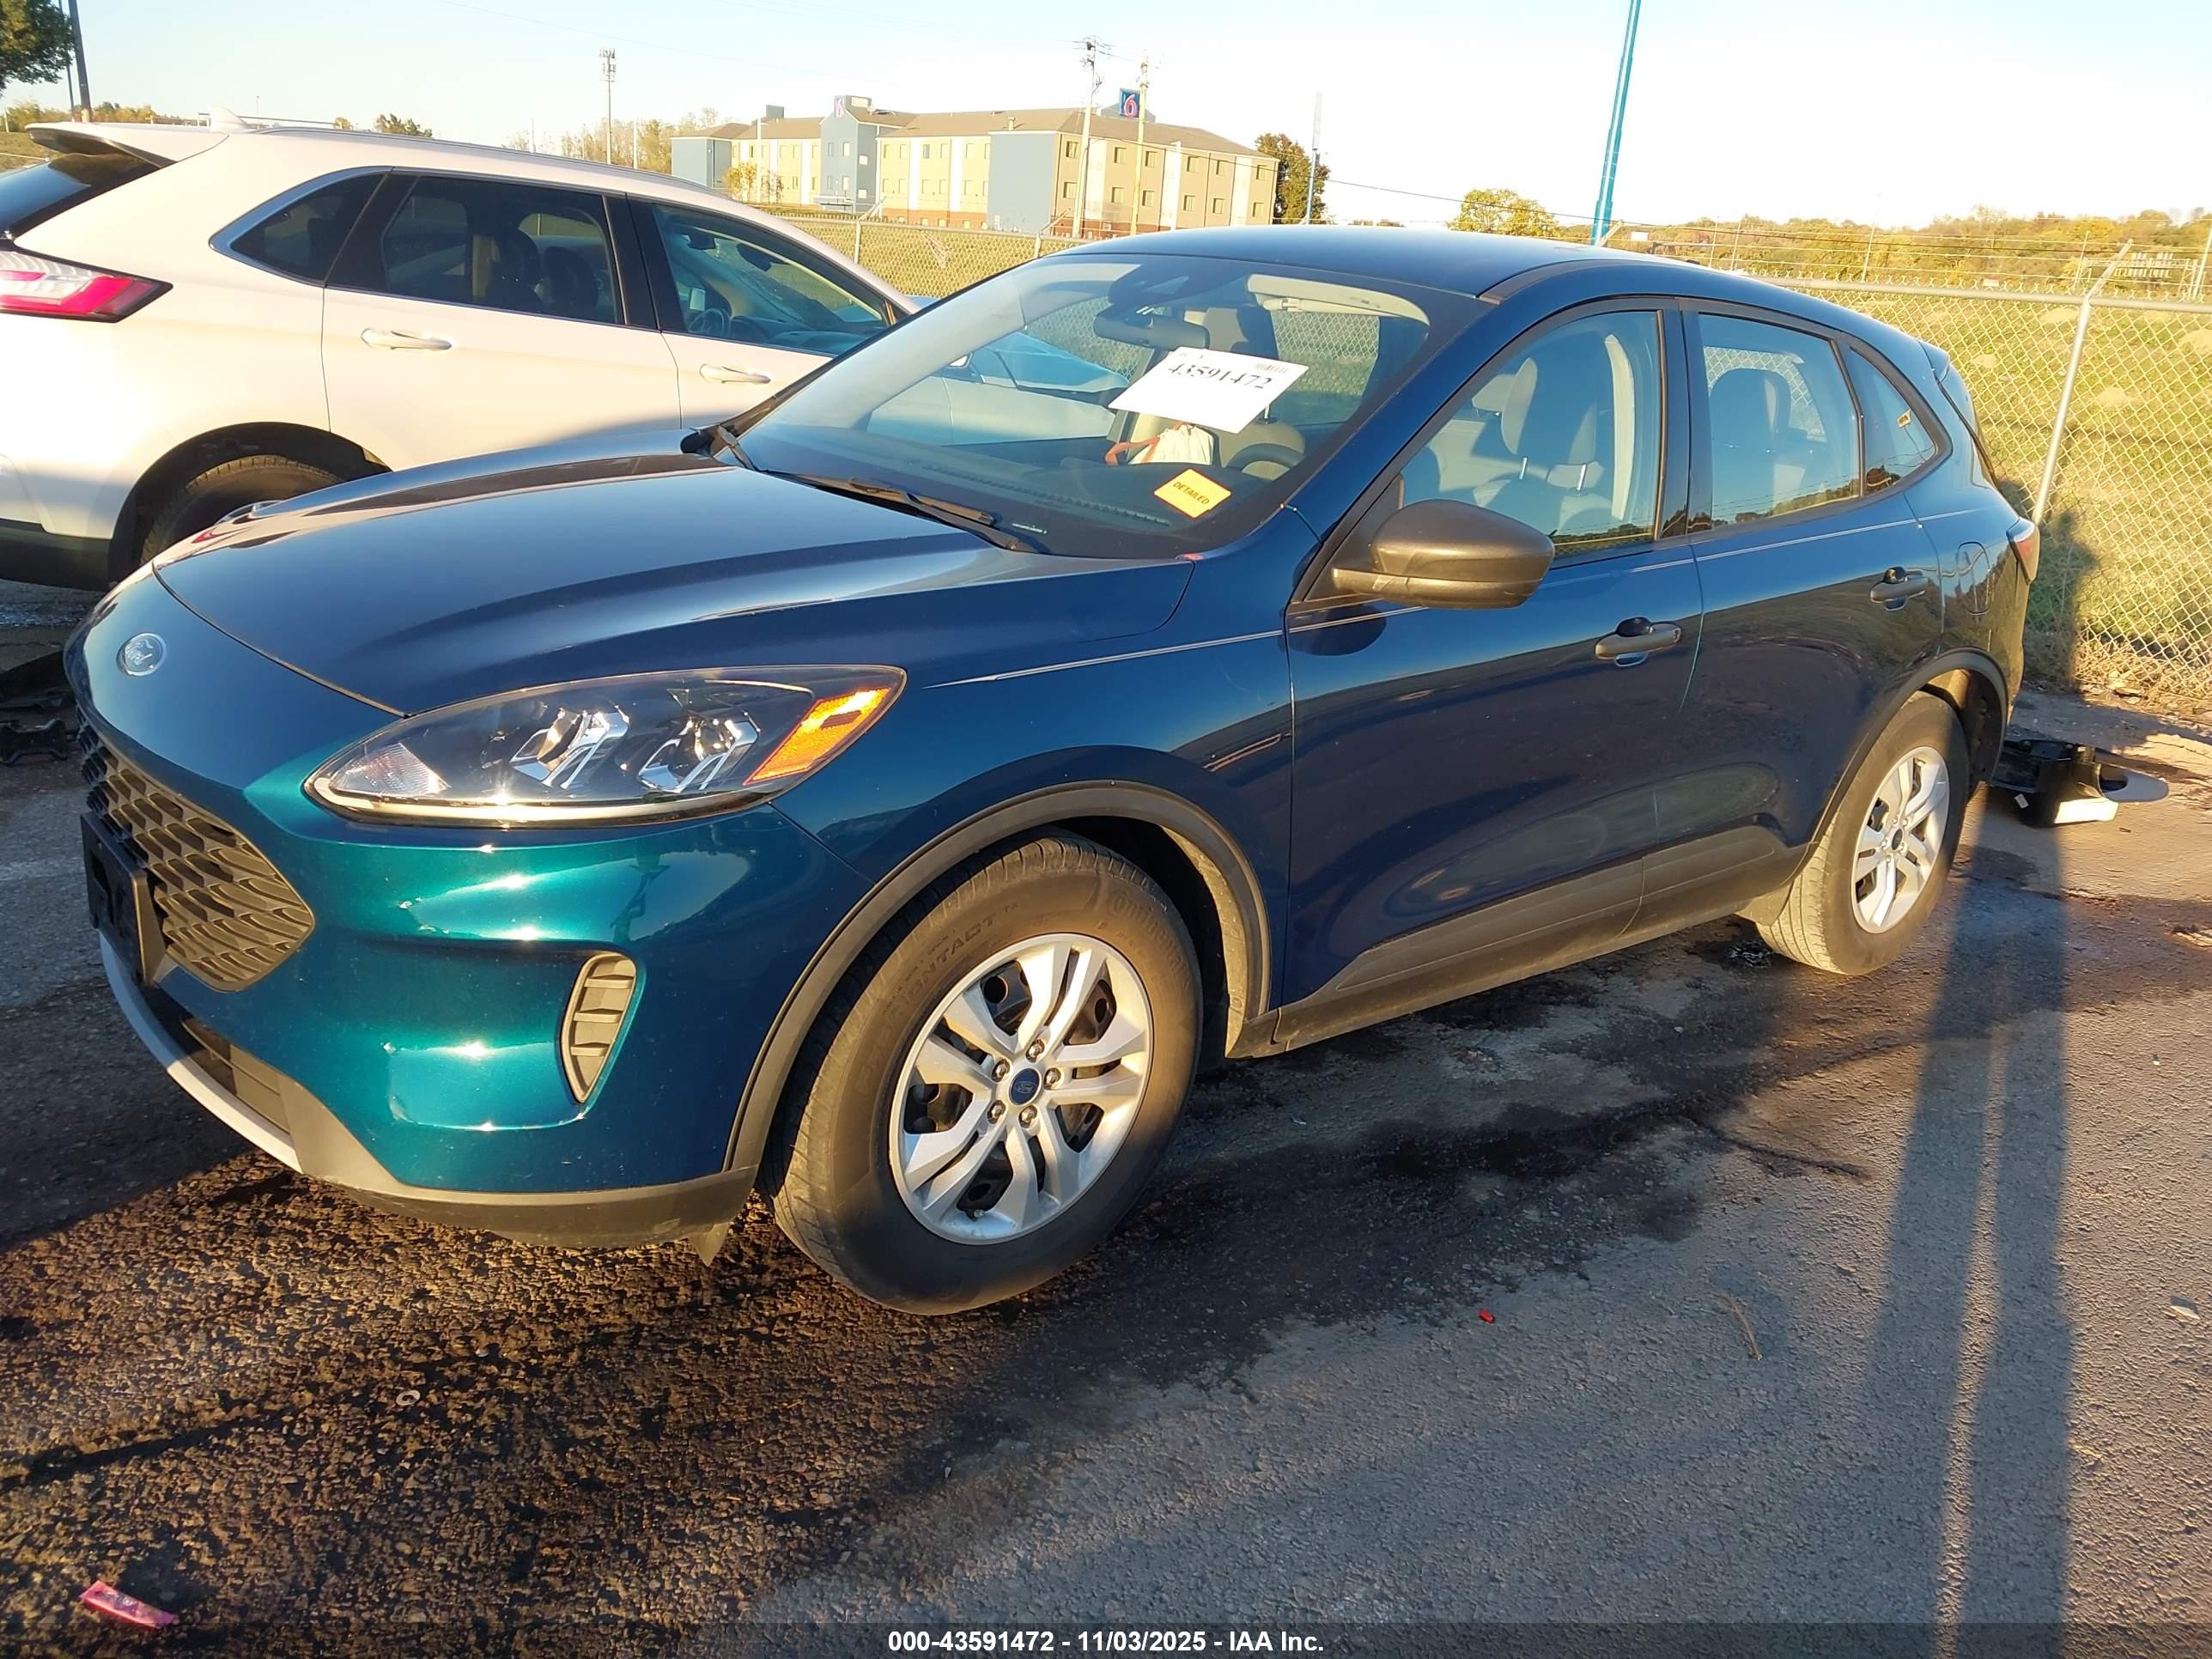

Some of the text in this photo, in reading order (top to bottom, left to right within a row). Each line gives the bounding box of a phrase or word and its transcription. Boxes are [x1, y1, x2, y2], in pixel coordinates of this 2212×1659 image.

[1123, 94, 1138, 117] 6
[1168, 362, 1273, 389] 43591472
[1173, 482, 1210, 505] DETAILED
